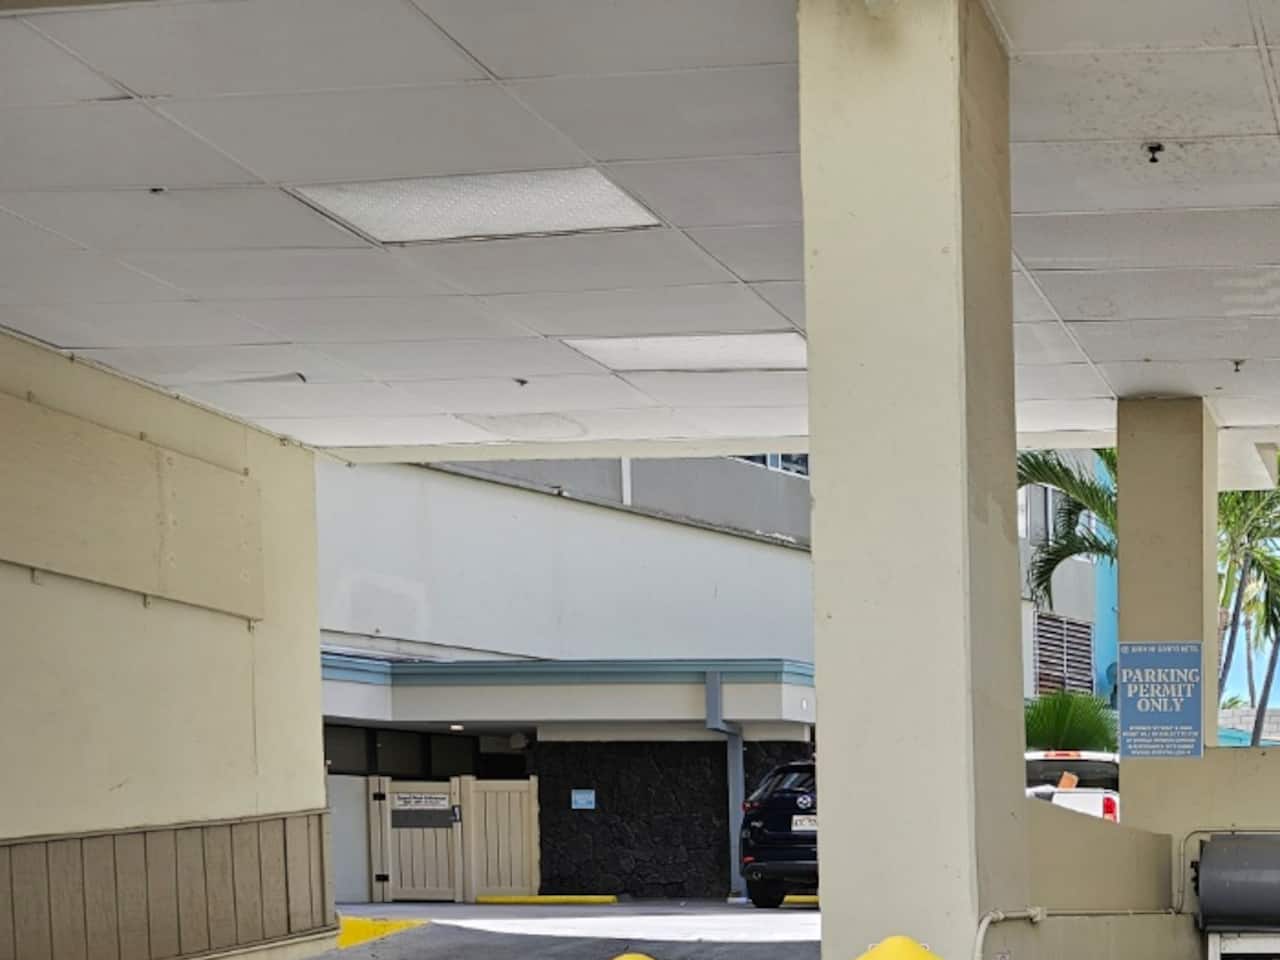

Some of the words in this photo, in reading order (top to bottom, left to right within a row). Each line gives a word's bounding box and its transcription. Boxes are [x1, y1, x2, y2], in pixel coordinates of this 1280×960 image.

[1121, 668, 1200, 683] PARKING
[1127, 683, 1195, 697] PERMIT
[1137, 698, 1184, 713] ONLY
